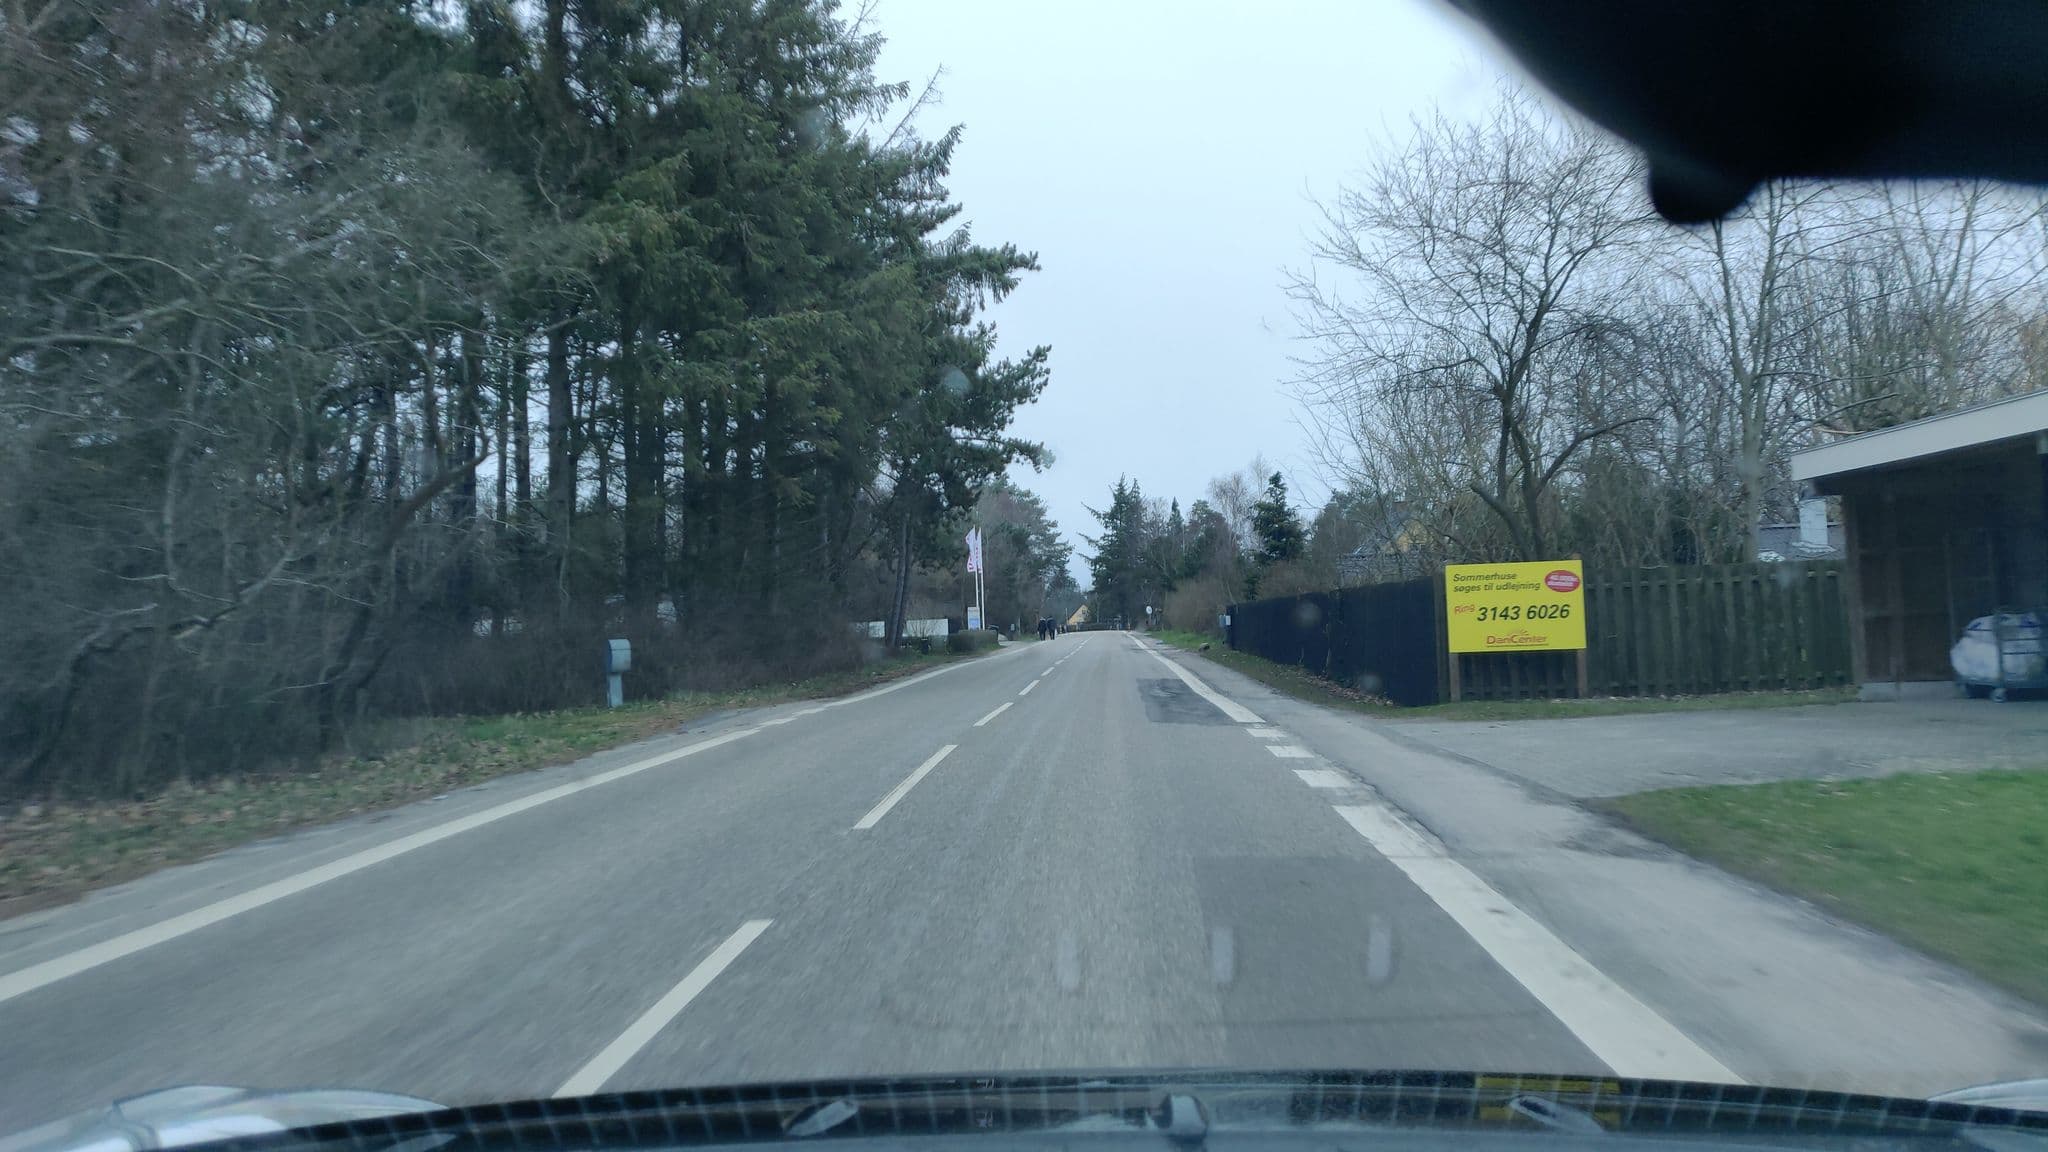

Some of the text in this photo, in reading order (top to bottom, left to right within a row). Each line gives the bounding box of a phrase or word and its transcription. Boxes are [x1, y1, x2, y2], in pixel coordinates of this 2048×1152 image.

[1453, 572, 1517, 582] Sommerhuse
[1453, 581, 1541, 593] søges til udlejning
[1454, 604, 1571, 621] Ring 3143 6026
[1486, 634, 1548, 645] DanCenter
